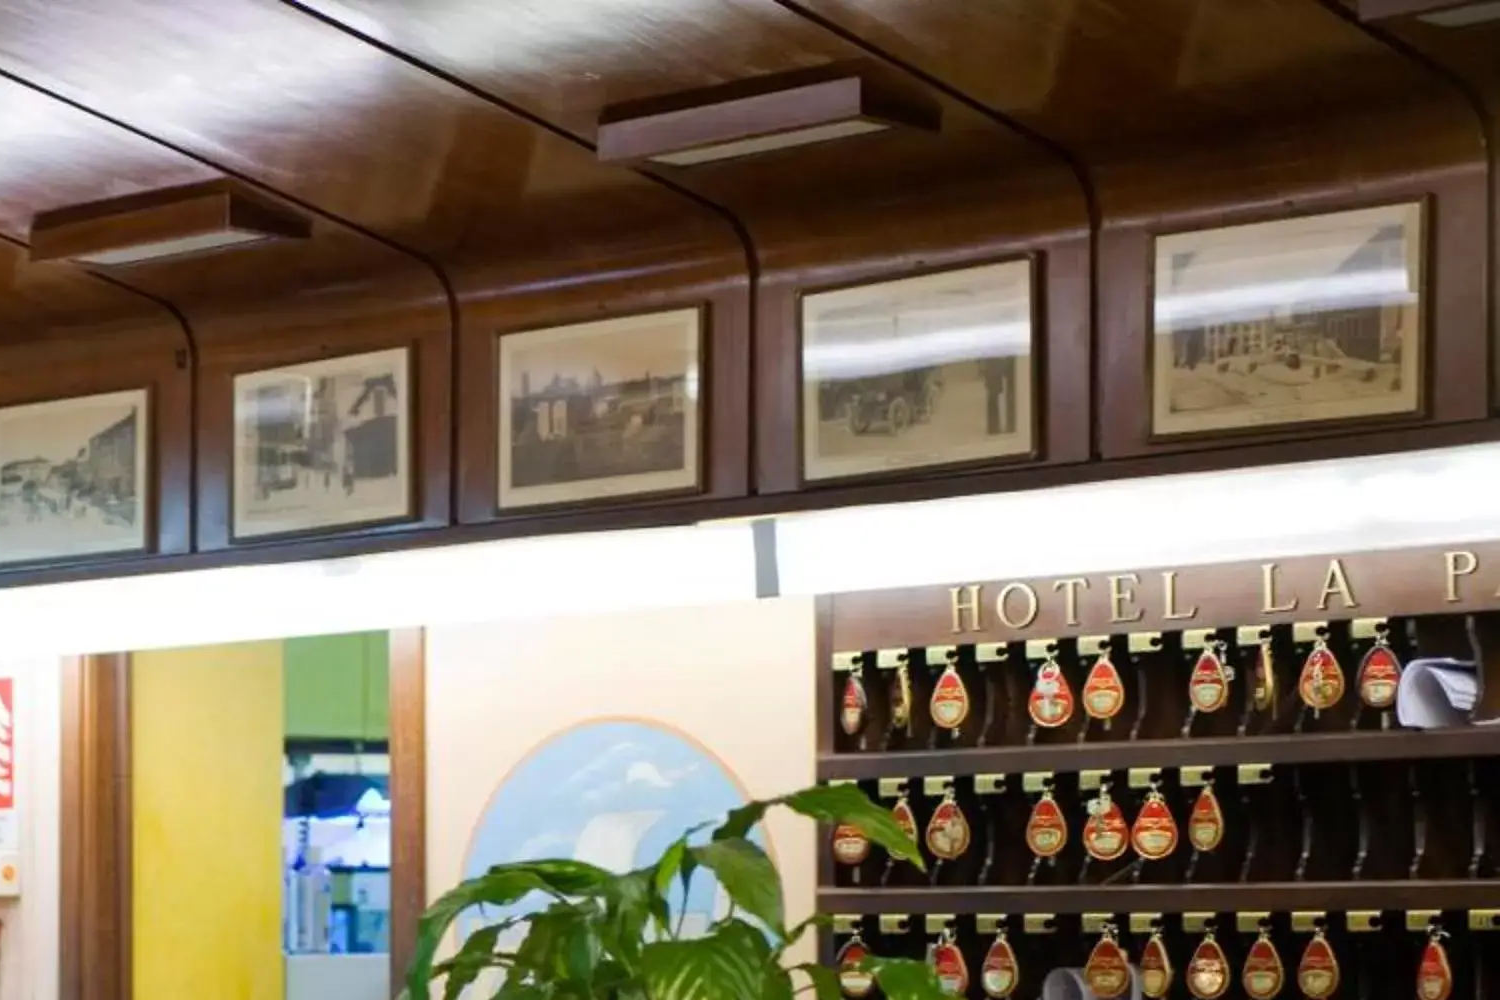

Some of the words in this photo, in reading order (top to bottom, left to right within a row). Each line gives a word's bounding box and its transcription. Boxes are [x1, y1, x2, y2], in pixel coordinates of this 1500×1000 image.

[949, 572, 1197, 633] HOTEL
[1260, 560, 1358, 613] LA
[1443, 550, 1500, 602] P
